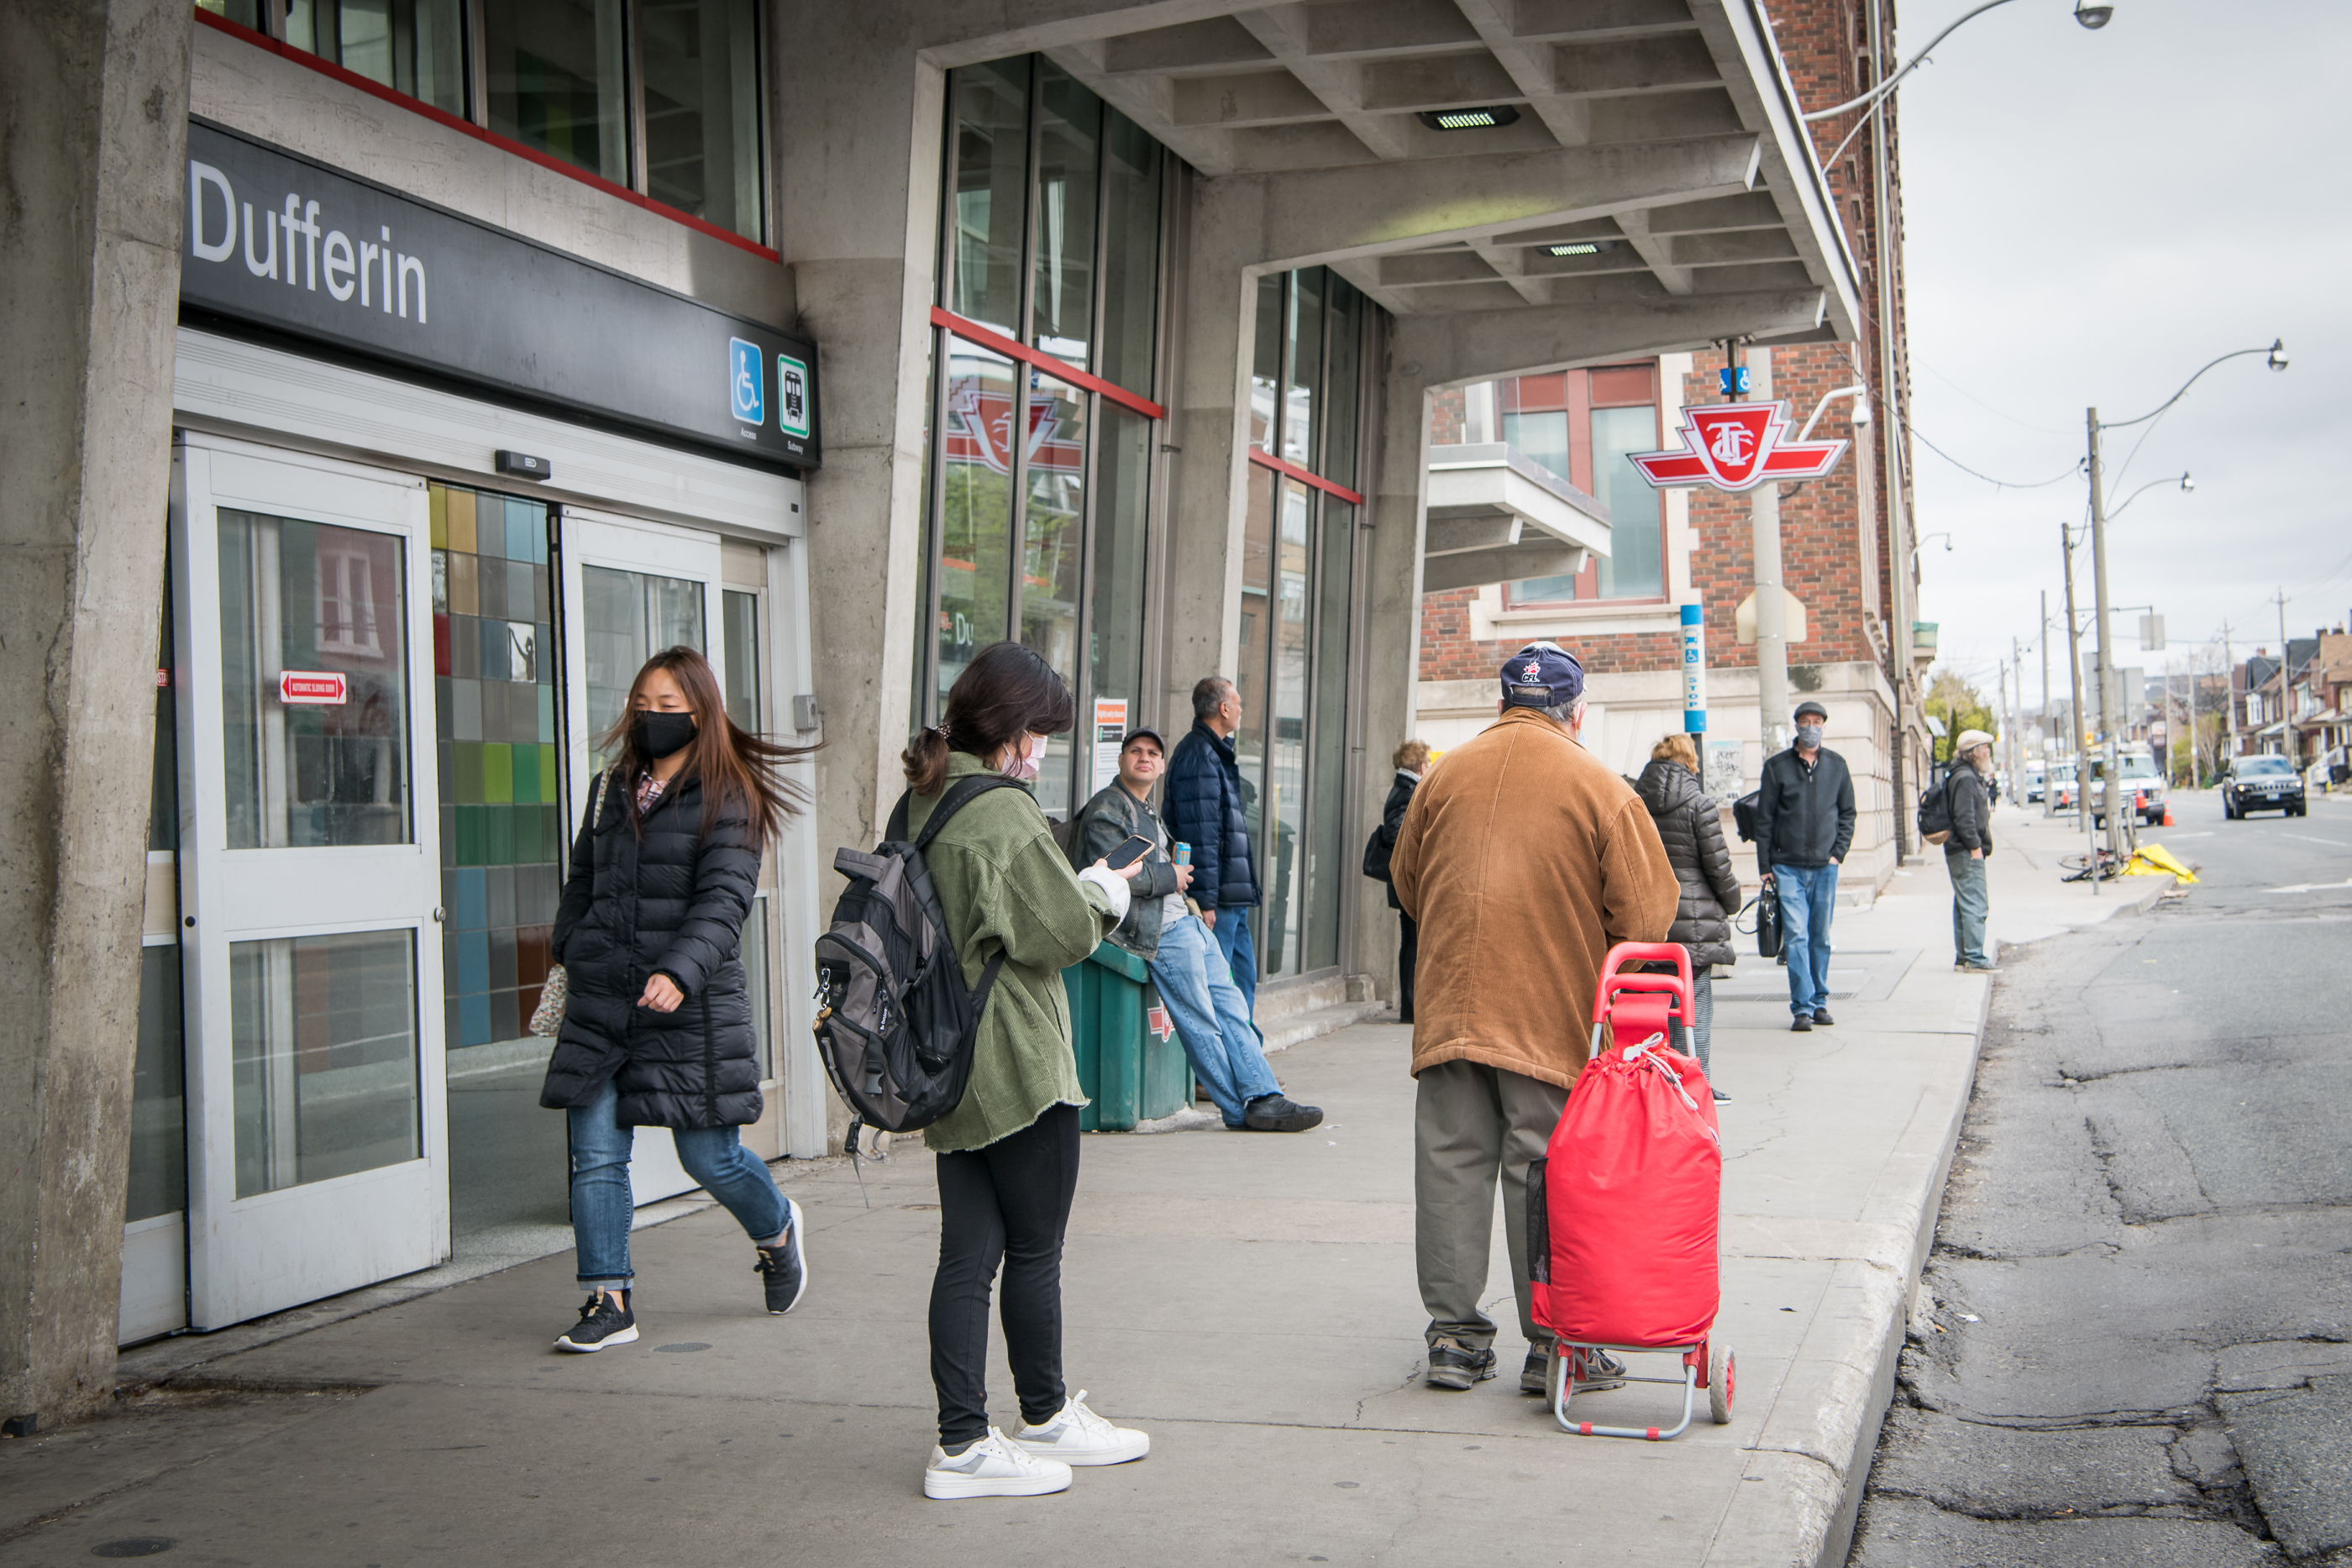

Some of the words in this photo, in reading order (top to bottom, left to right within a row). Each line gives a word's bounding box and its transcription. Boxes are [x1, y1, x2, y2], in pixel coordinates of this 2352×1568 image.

[191, 160, 427, 323] Dufferin
[741, 427, 757, 440] Access
[788, 440, 804, 455] Subway
[1522, 674, 1537, 682] CFL
[1688, 677, 1698, 707] STOP
